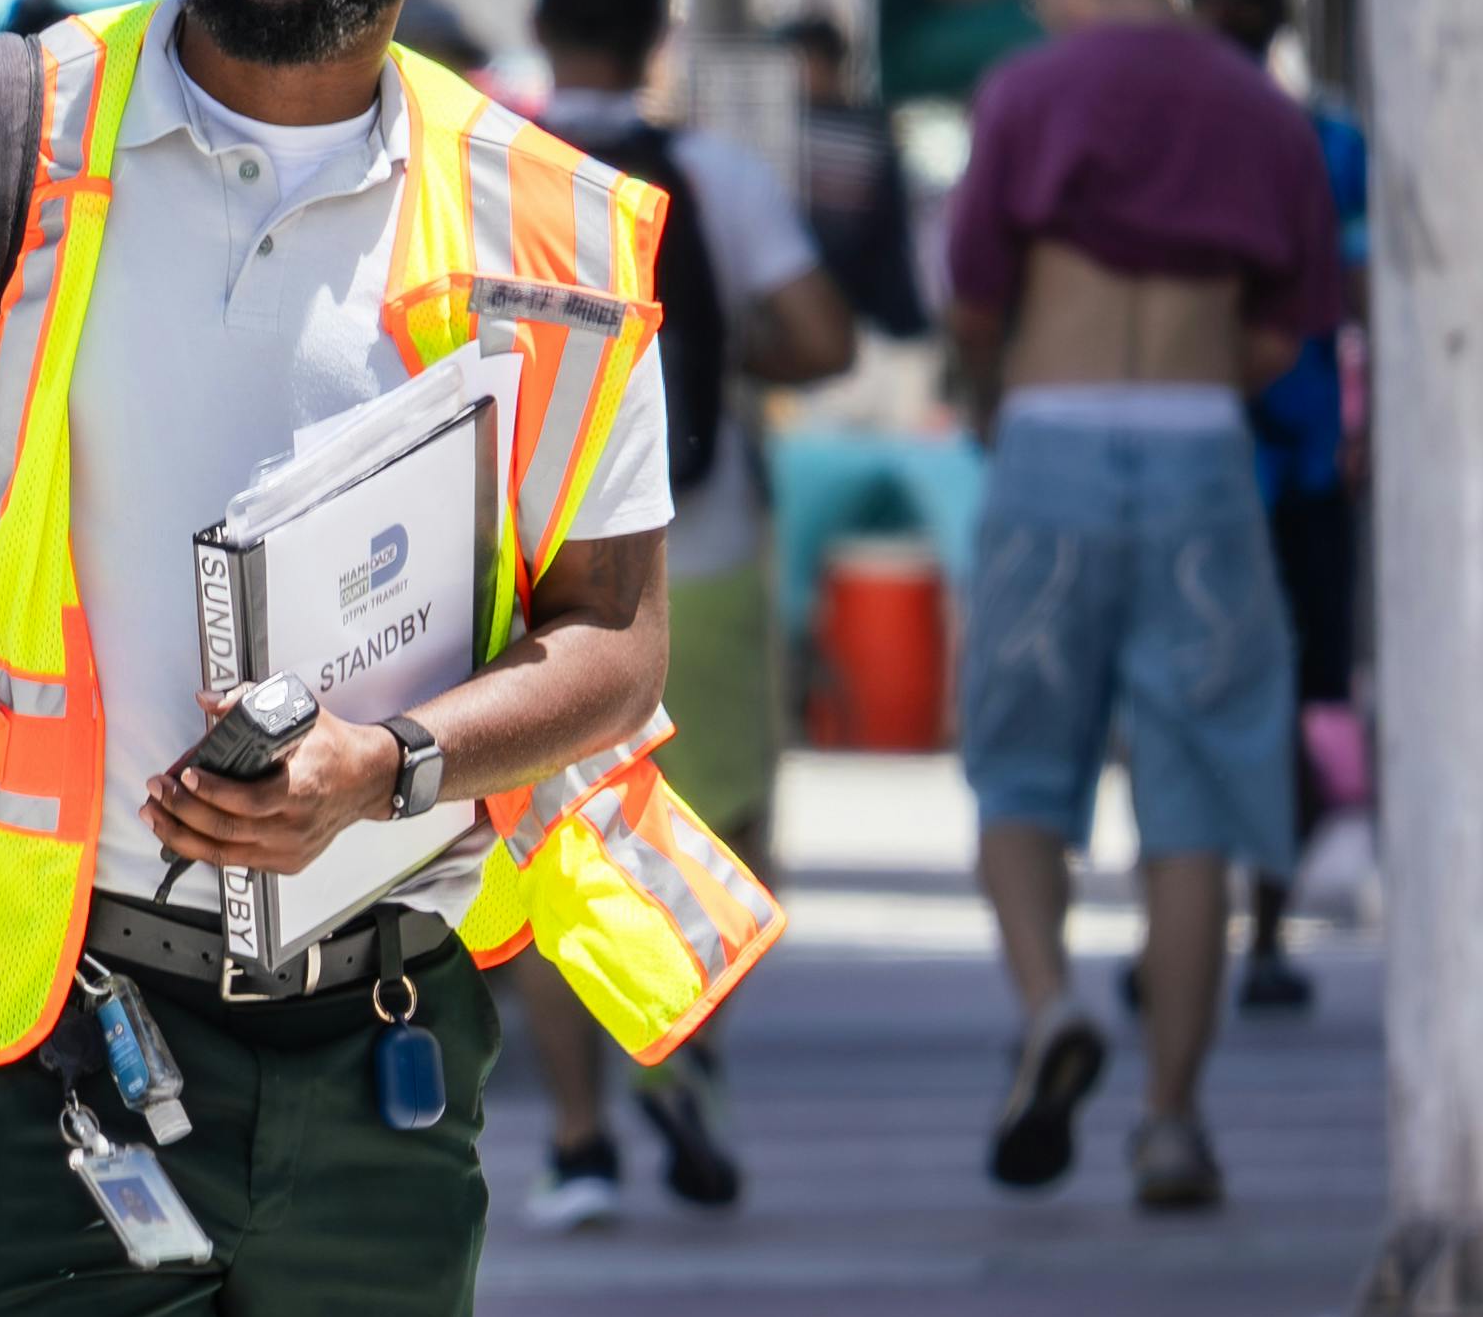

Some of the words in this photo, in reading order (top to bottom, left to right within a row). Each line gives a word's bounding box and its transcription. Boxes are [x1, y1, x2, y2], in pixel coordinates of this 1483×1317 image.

[201, 555, 236, 683] SUNDA
[320, 601, 433, 694] STANDBY
[342, 601, 368, 627] DTPW
[371, 577, 410, 610] TRANSIT
